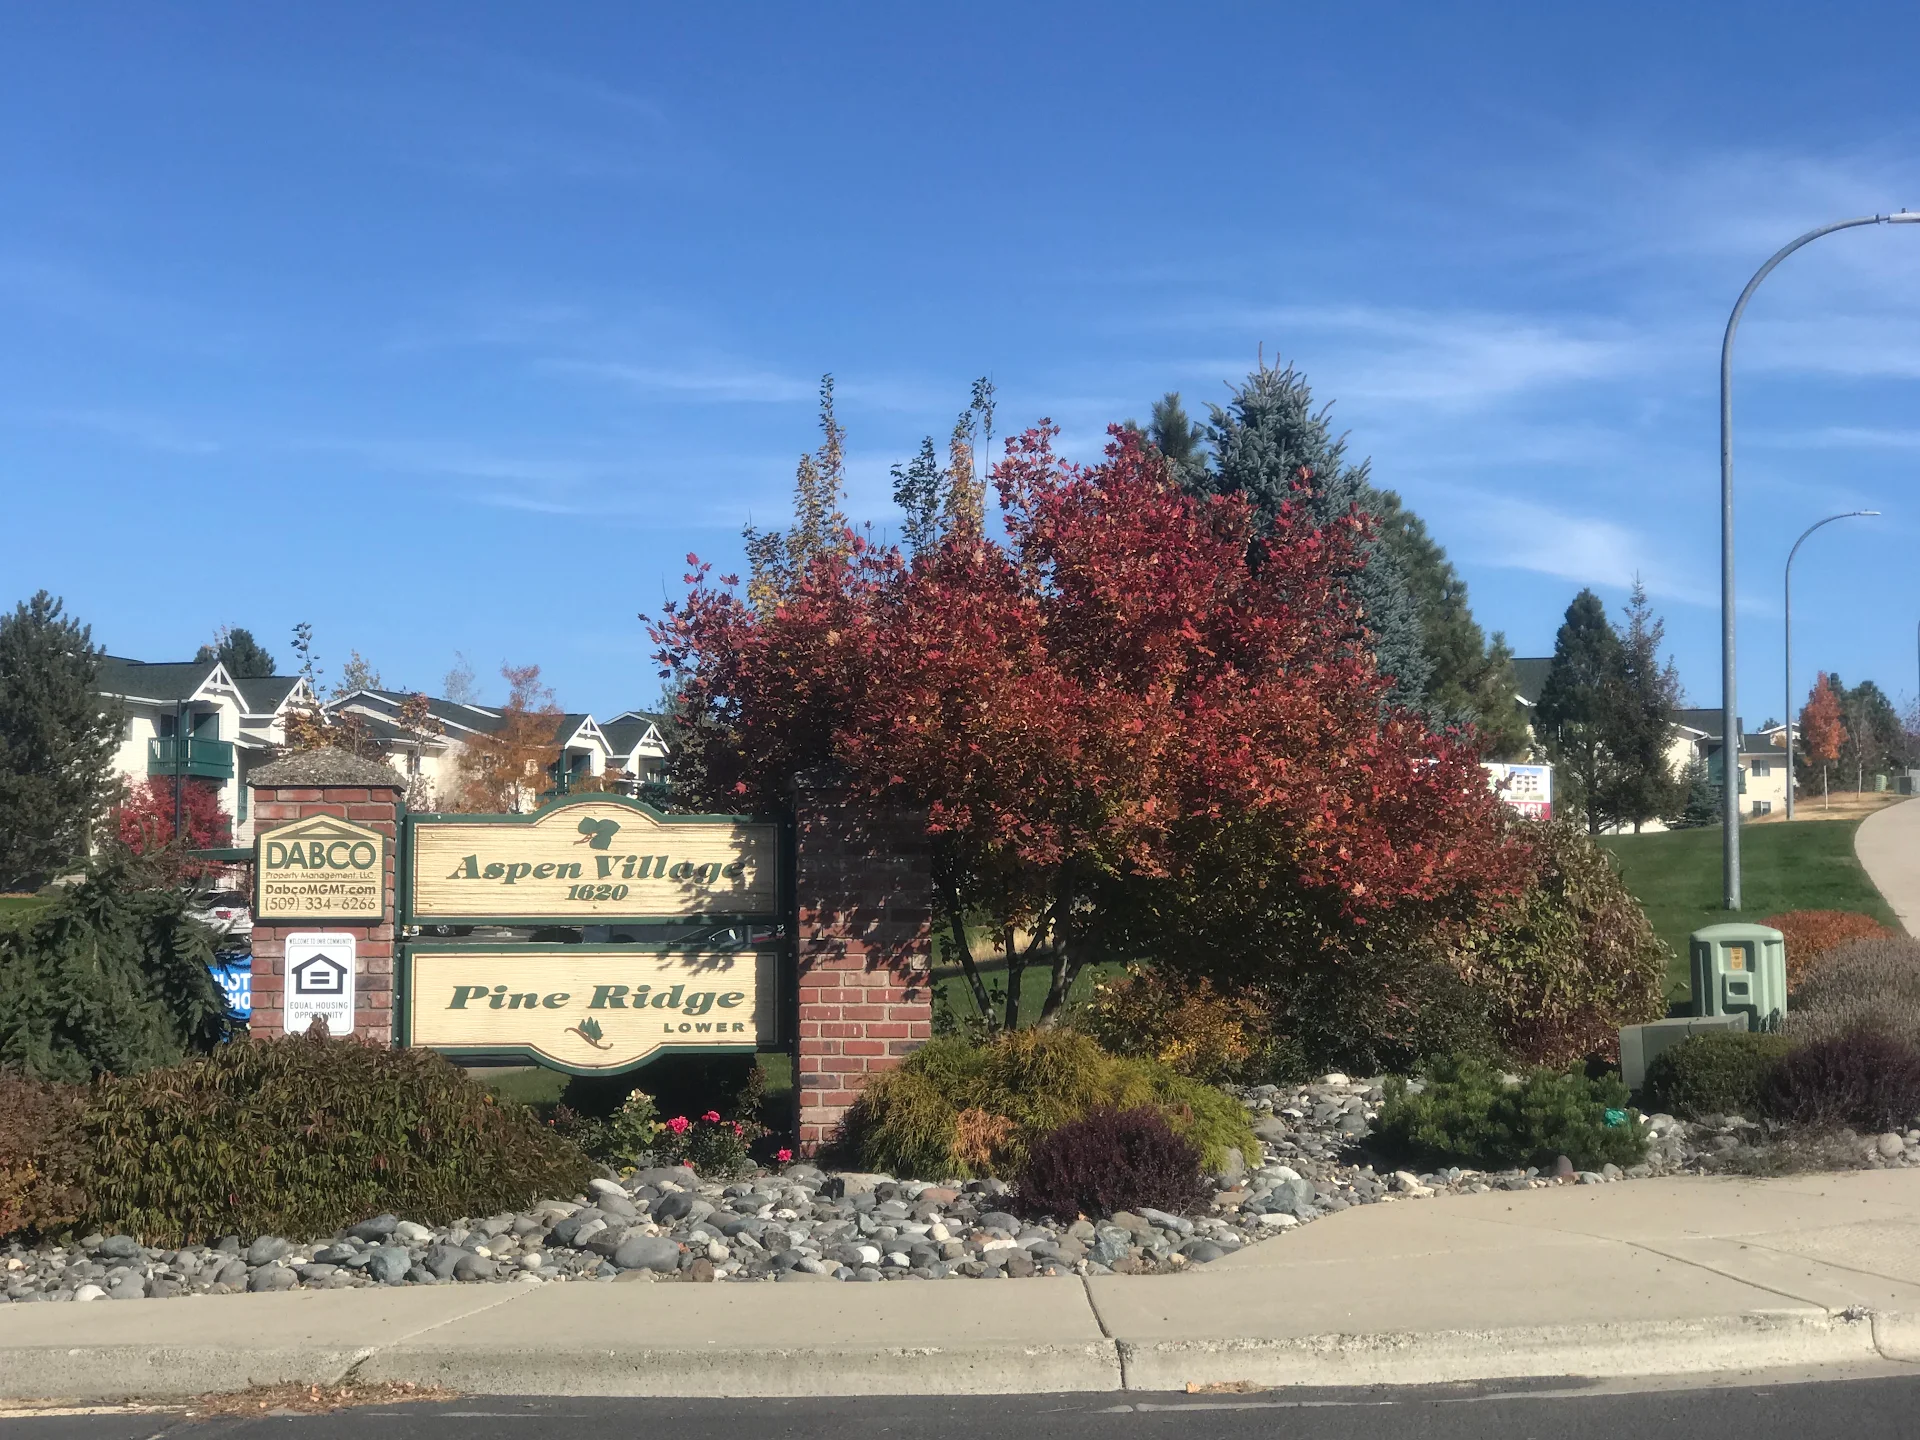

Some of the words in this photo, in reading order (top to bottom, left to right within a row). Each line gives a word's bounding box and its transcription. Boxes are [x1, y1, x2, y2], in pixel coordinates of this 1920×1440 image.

[266, 841, 377, 870] DABCO
[446, 854, 583, 884] Aspen
[594, 855, 745, 884] Village
[265, 884, 376, 895] DabcoMGMT.com
[565, 884, 629, 901] 1620
[265, 897, 300, 911] (509)
[305, 897, 376, 910] 334-6266
[289, 1001, 313, 1010] EQUAL
[315, 1001, 348, 1010] HOUSING
[445, 985, 571, 1010] Pine
[588, 984, 745, 1015] Ridge
[664, 1022, 745, 1034] LOWER
